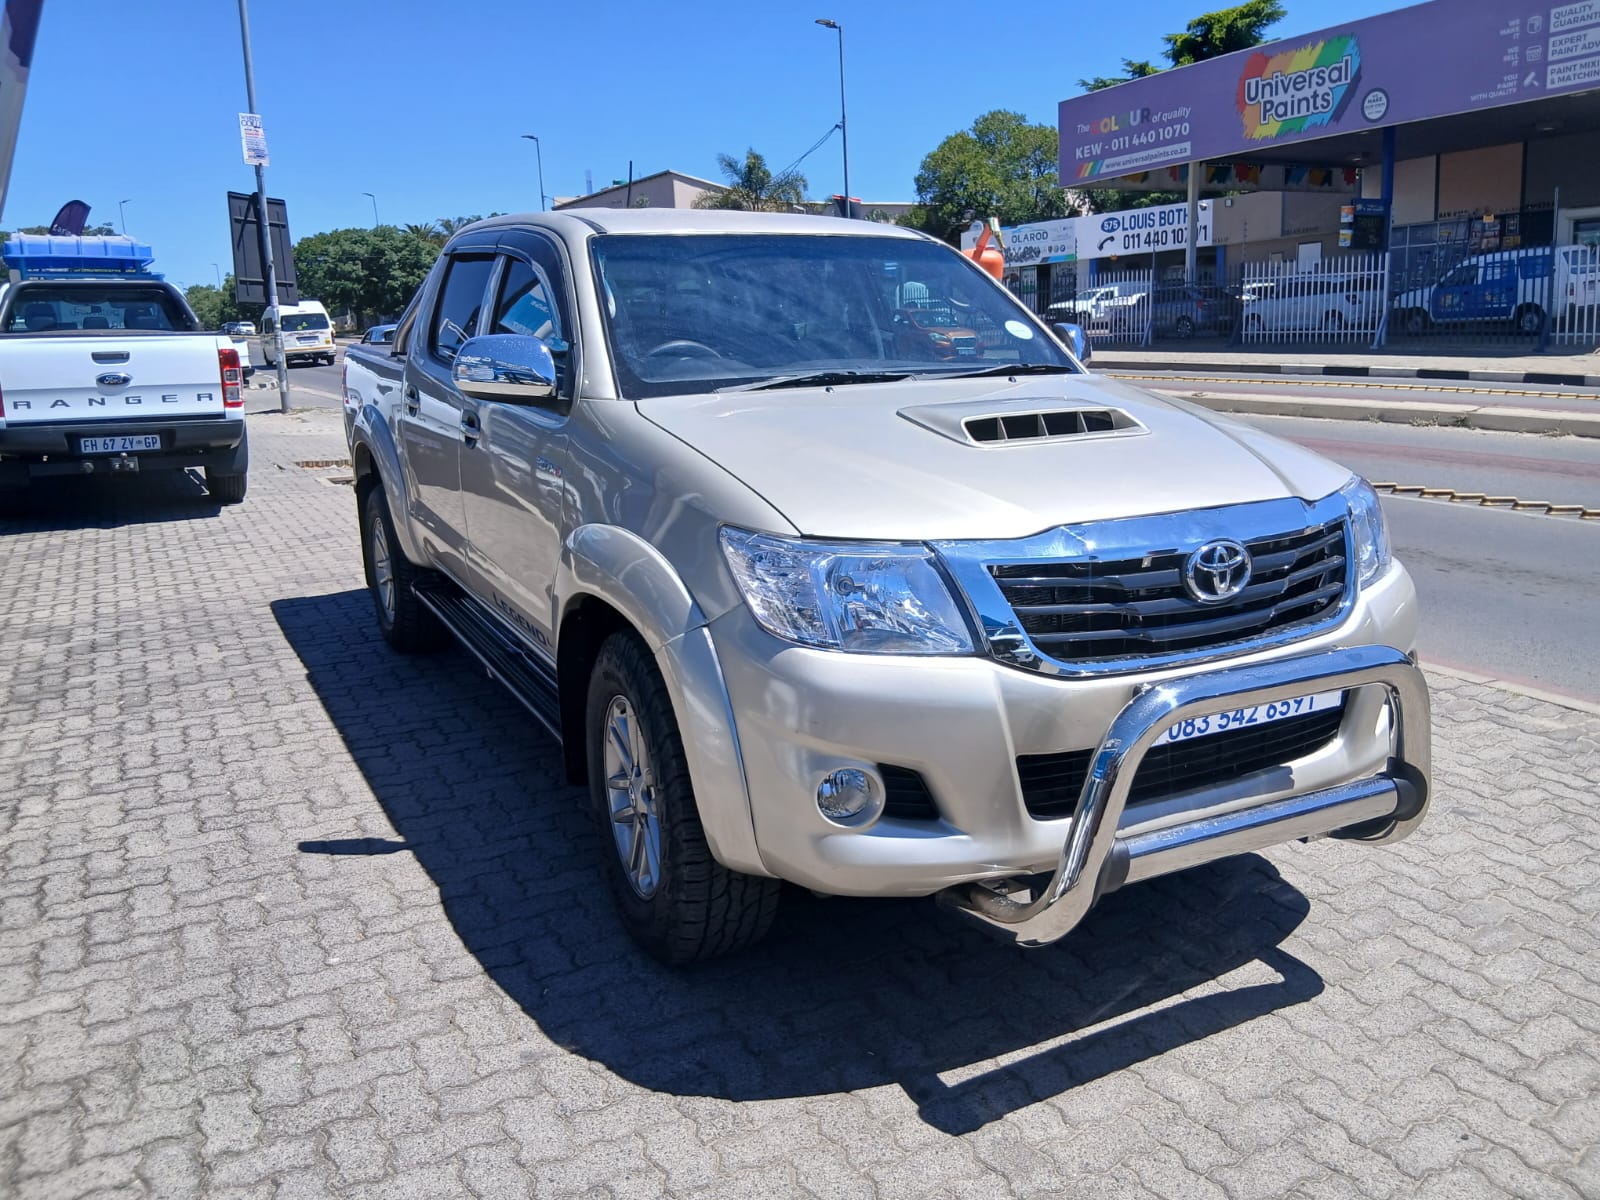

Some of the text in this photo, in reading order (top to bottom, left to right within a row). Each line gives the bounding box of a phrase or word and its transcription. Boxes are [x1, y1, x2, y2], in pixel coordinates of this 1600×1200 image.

[1553, 3, 1593, 20] QUALITY
[1552, 33, 1588, 48] EXPERT
[1551, 45, 1578, 57] PAINT
[1504, 73, 1518, 82] YOU
[1550, 63, 1577, 76] PAINT
[1244, 57, 1351, 103] Universal
[1470, 86, 1517, 101] WITH QUALITY
[1261, 88, 1332, 123] Paints
[1077, 106, 1191, 135] The COLOUR of quality
[1075, 142, 1103, 160] KEW
[1111, 136, 1129, 151] 011
[1132, 130, 1156, 146] 440
[1158, 122, 1190, 140] 1070
[1105, 146, 1188, 169] www.universalpaints.co.za
[1103, 220, 1119, 231] 575
[1121, 211, 1156, 232] LOUIS
[1011, 231, 1049, 244] OLAROD
[1123, 234, 1141, 250] 011
[1143, 230, 1168, 247] 440
[103, 374, 124, 385] Ford
[12, 391, 214, 410] RANGER
[83, 434, 159, 451] FH 67 ZY GP
[492, 591, 548, 646] LEGEND
[1167, 715, 1210, 740] 083
[1217, 706, 1260, 731] 542
